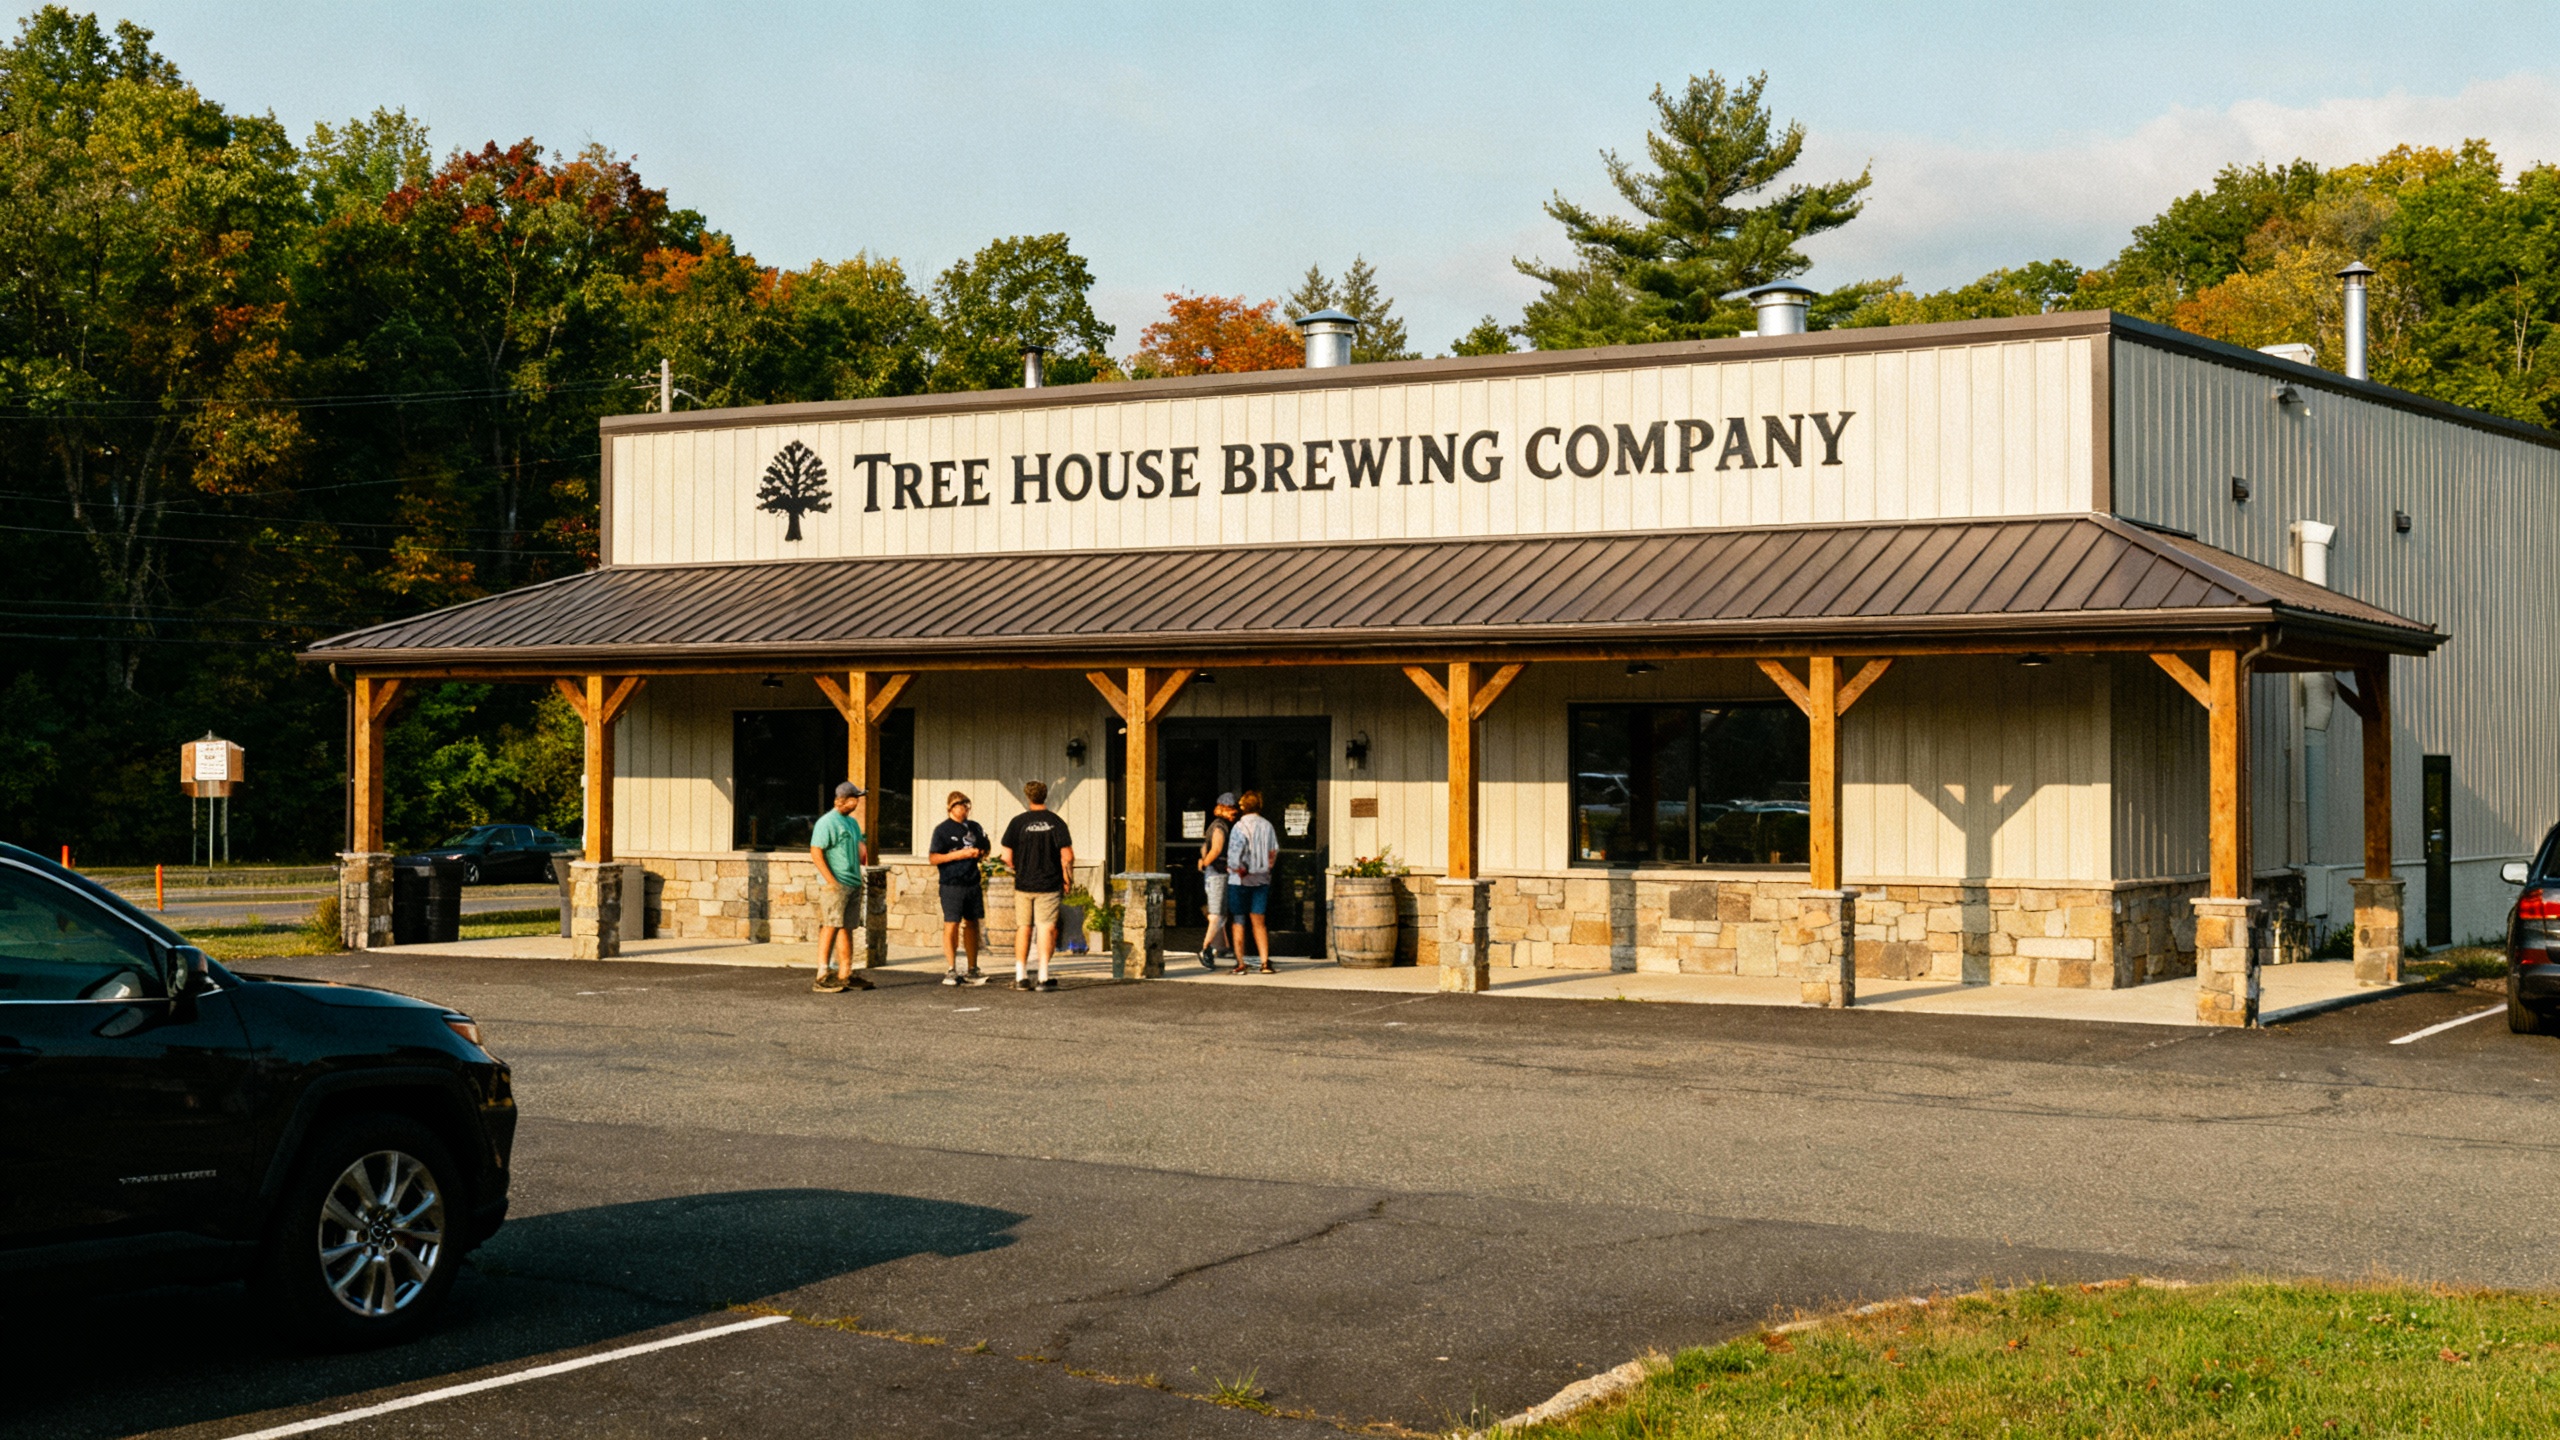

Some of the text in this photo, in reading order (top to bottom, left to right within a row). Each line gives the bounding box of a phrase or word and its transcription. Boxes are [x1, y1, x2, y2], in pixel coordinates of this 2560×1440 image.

[853, 411, 1856, 513] TREE HOUSE BREWING COMPANY
